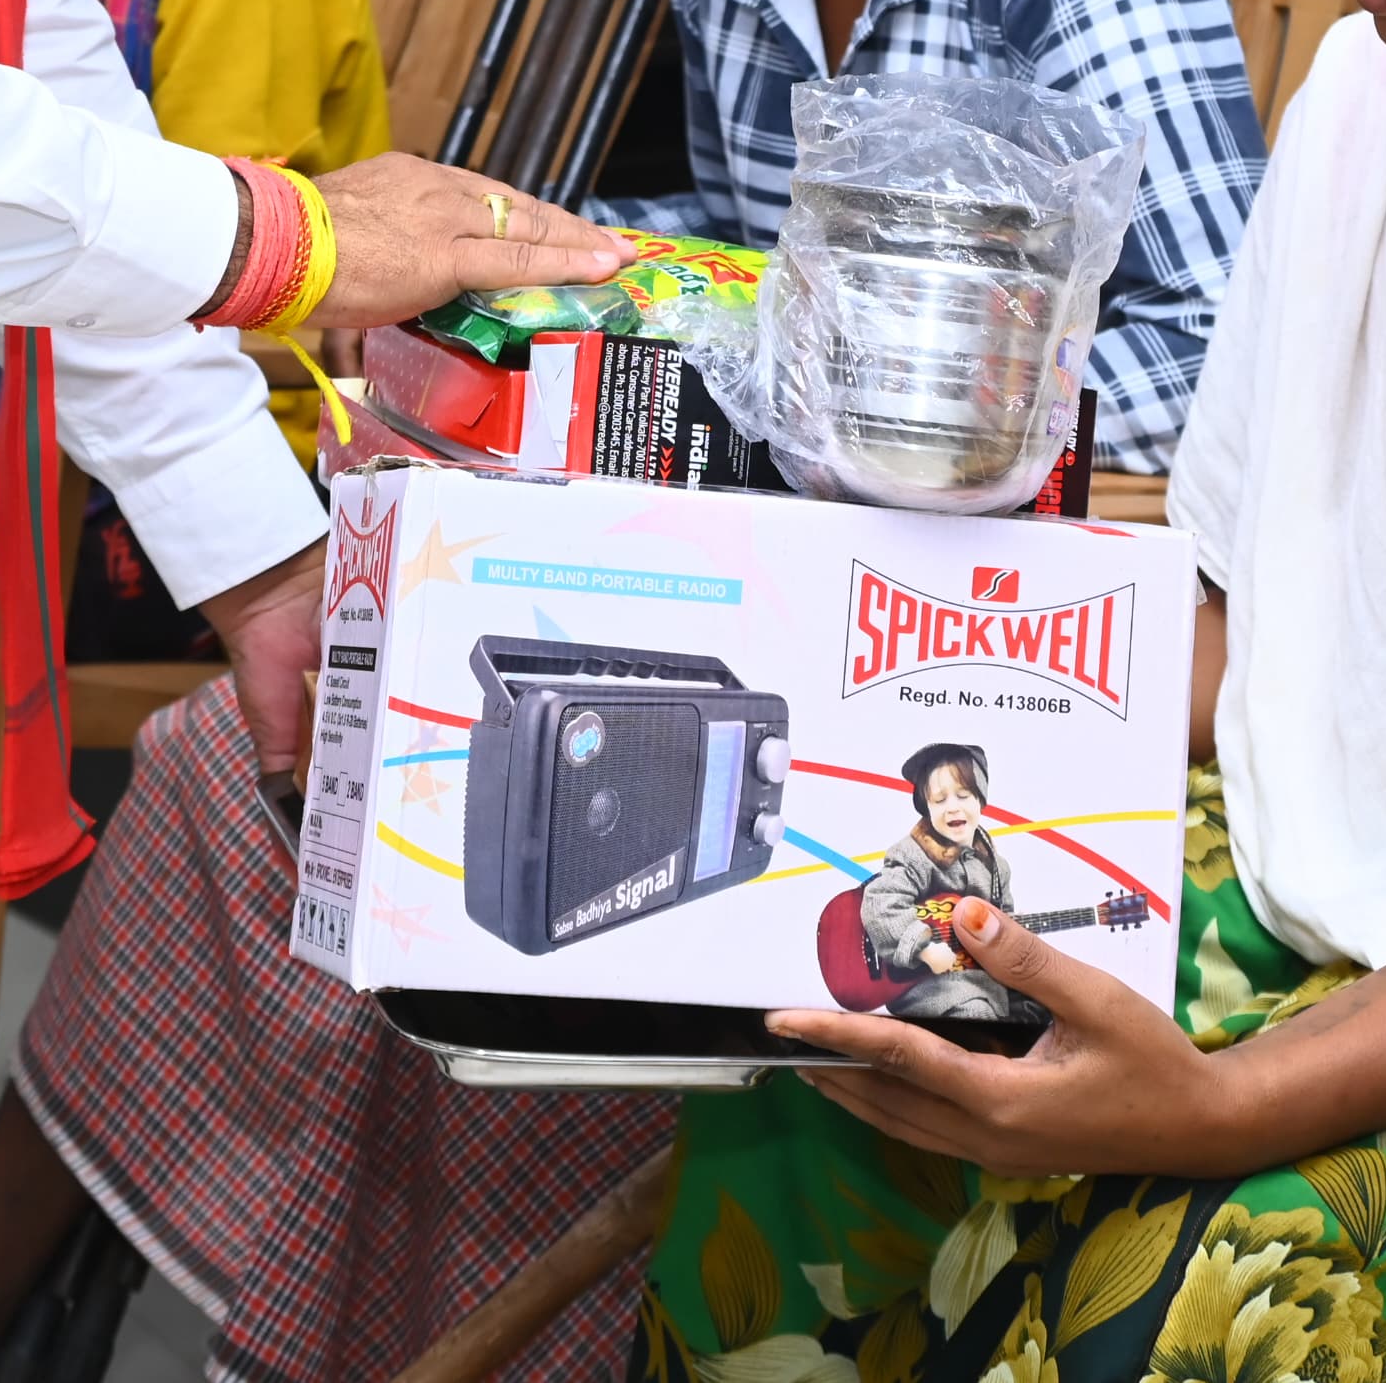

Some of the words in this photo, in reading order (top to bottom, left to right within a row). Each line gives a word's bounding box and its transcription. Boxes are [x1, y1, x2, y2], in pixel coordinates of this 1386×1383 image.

[616, 343, 628, 372] above.
[631, 345, 643, 368] India.
[643, 346, 655, 354] 2,
[640, 356, 654, 384] Rainey
[654, 348, 666, 417] INDUSTRIES
[626, 370, 640, 410] Consumer
[637, 387, 651, 409] Park,
[661, 348, 682, 445] EVEREADY
[595, 342, 615, 475] consumercare@eveready.co.in
[650, 420, 661, 453] INDIA
[621, 467, 630, 477] as
[687, 423, 711, 491] india
[329, 510, 392, 610] SPICKWELL
[487, 564, 539, 583] MULTY
[543, 568, 587, 587] BAND
[592, 573, 674, 595] PORTABLE
[677, 580, 727, 599] RADIO
[852, 572, 1120, 705] SPICKWELL
[899, 686, 952, 707] Regd.
[958, 691, 988, 709] No.
[994, 693, 1072, 715] 413806B
[351, 781, 364, 802] BAND
[554, 919, 574, 937] Sabse
[575, 897, 612, 928] Badhiya
[615, 854, 677, 910] Signal
